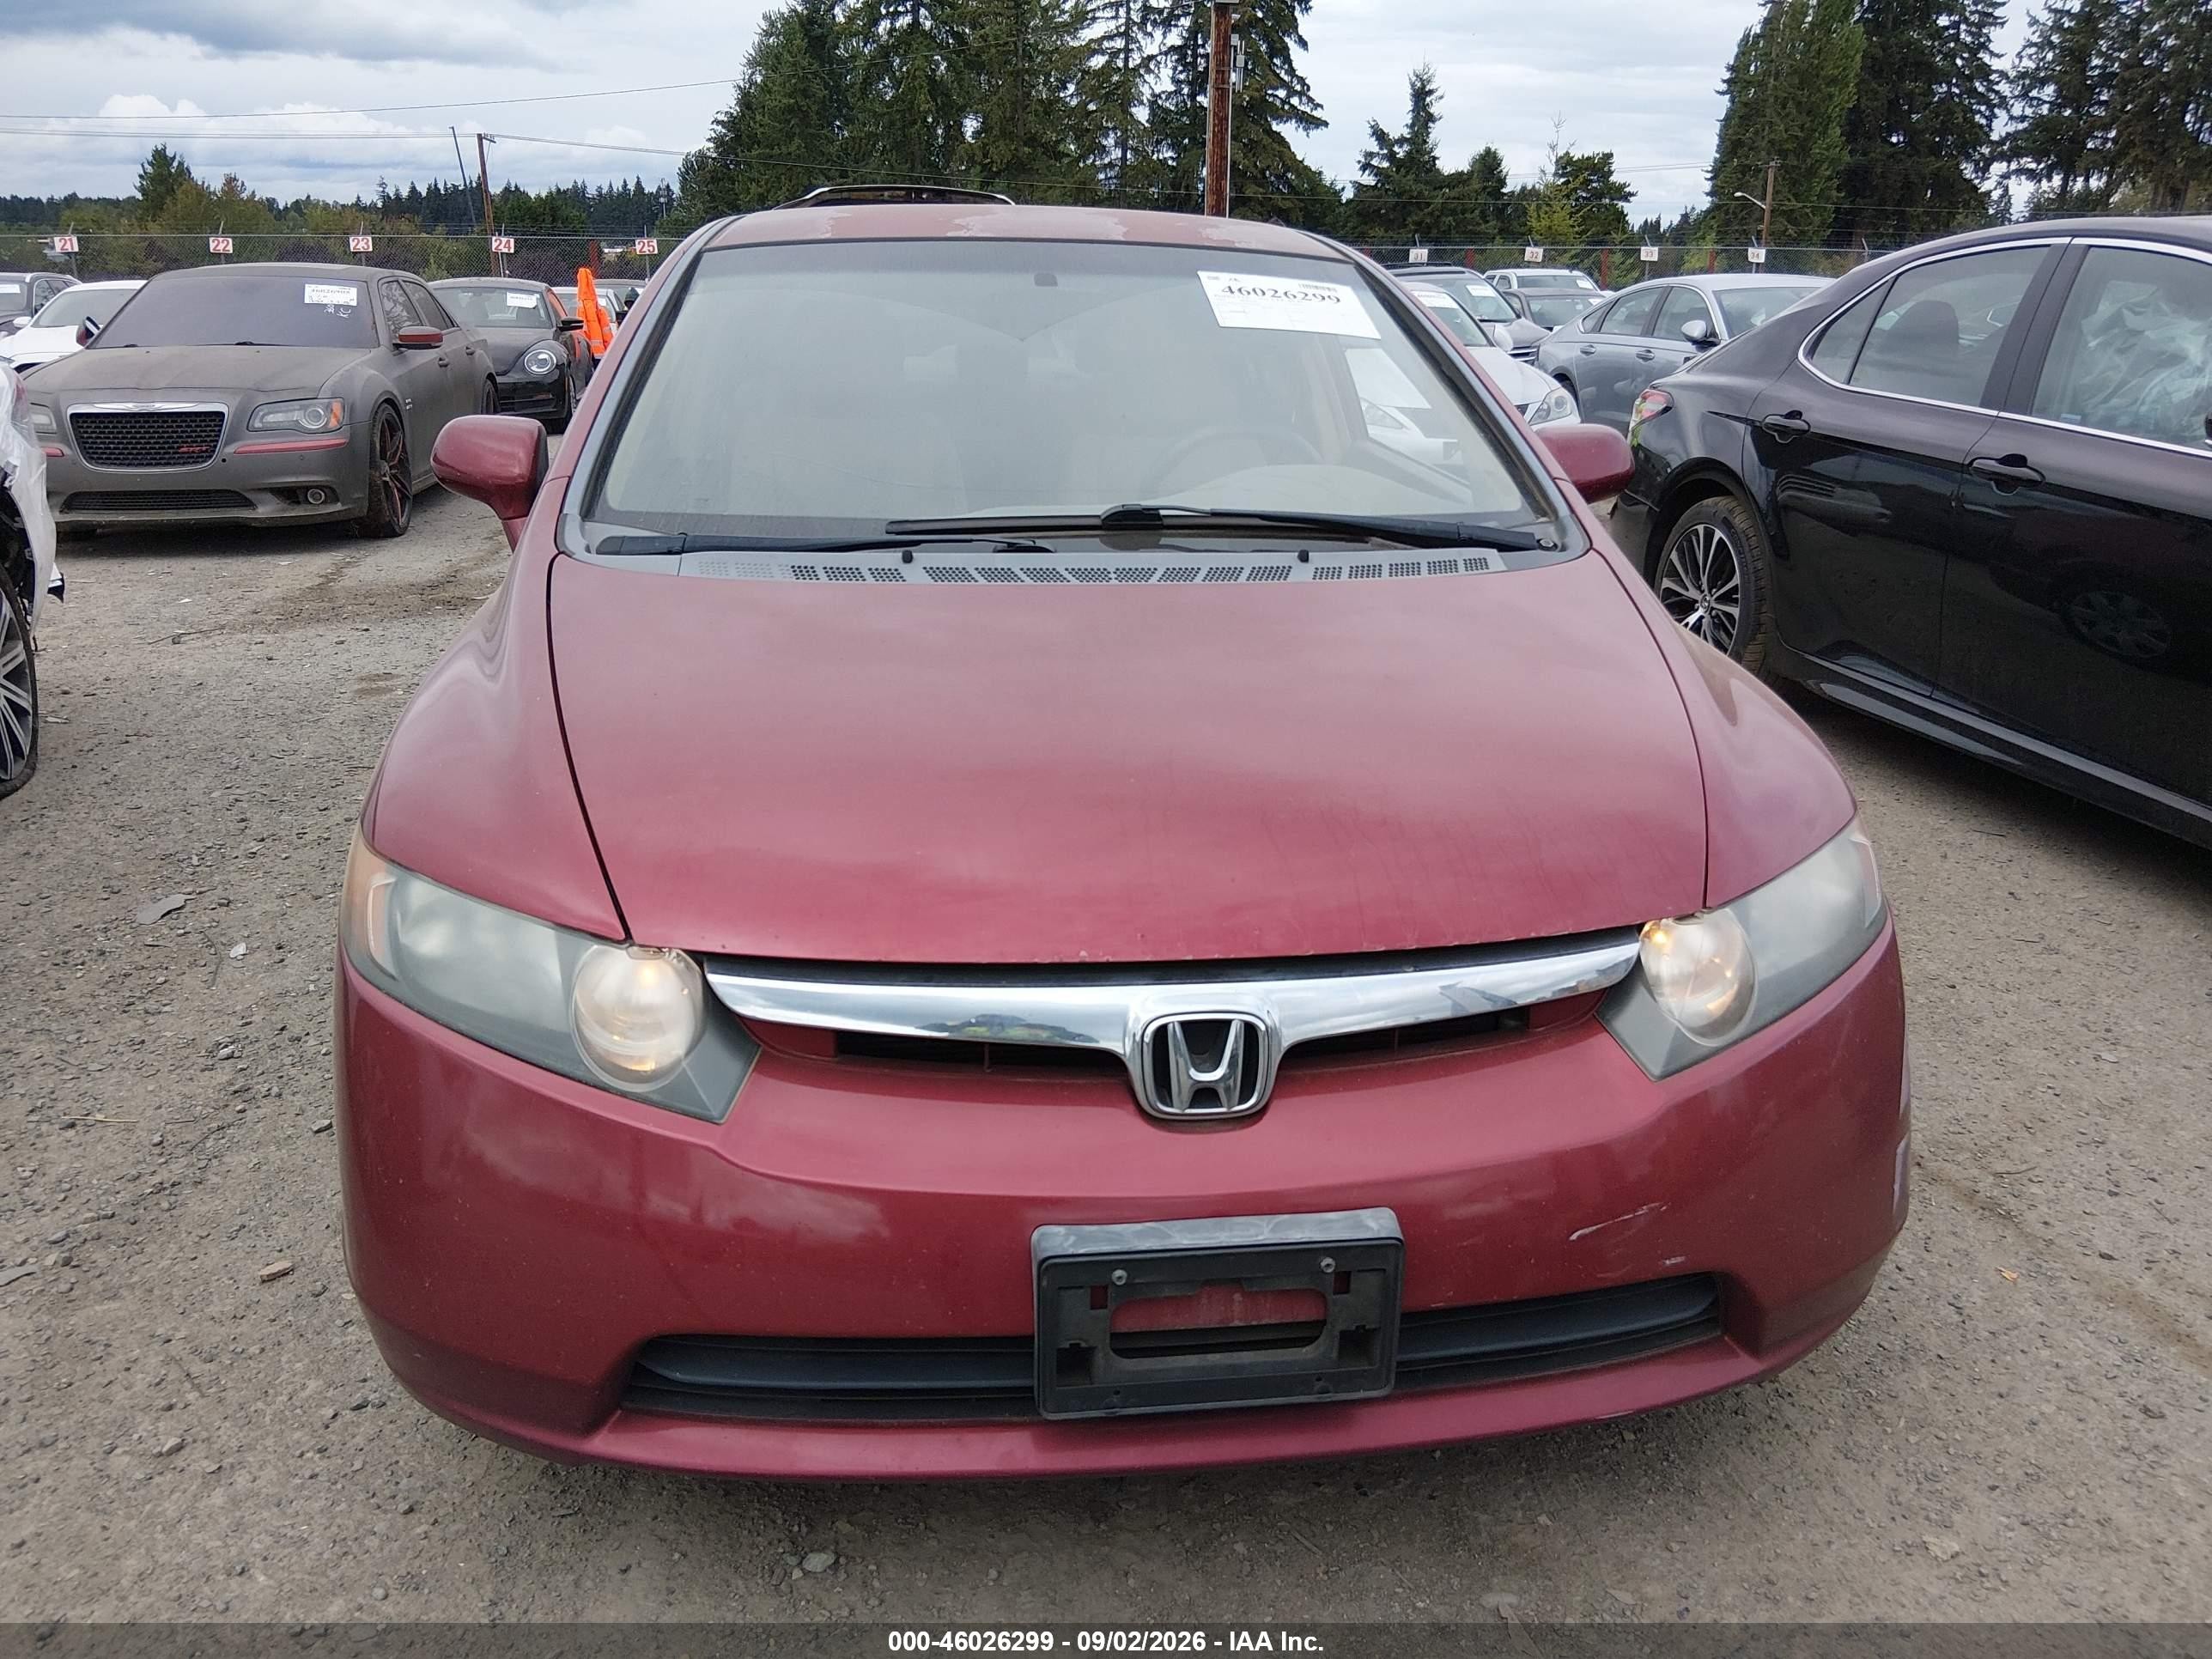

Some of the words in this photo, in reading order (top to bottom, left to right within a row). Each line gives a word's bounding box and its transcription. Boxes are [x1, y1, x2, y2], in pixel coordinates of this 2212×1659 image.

[58, 237, 75, 251] 21
[211, 239, 230, 252] 22
[351, 237, 370, 251] 23
[494, 238, 512, 252] 24
[637, 240, 655, 253] 25
[1221, 284, 1341, 304] 46026299
